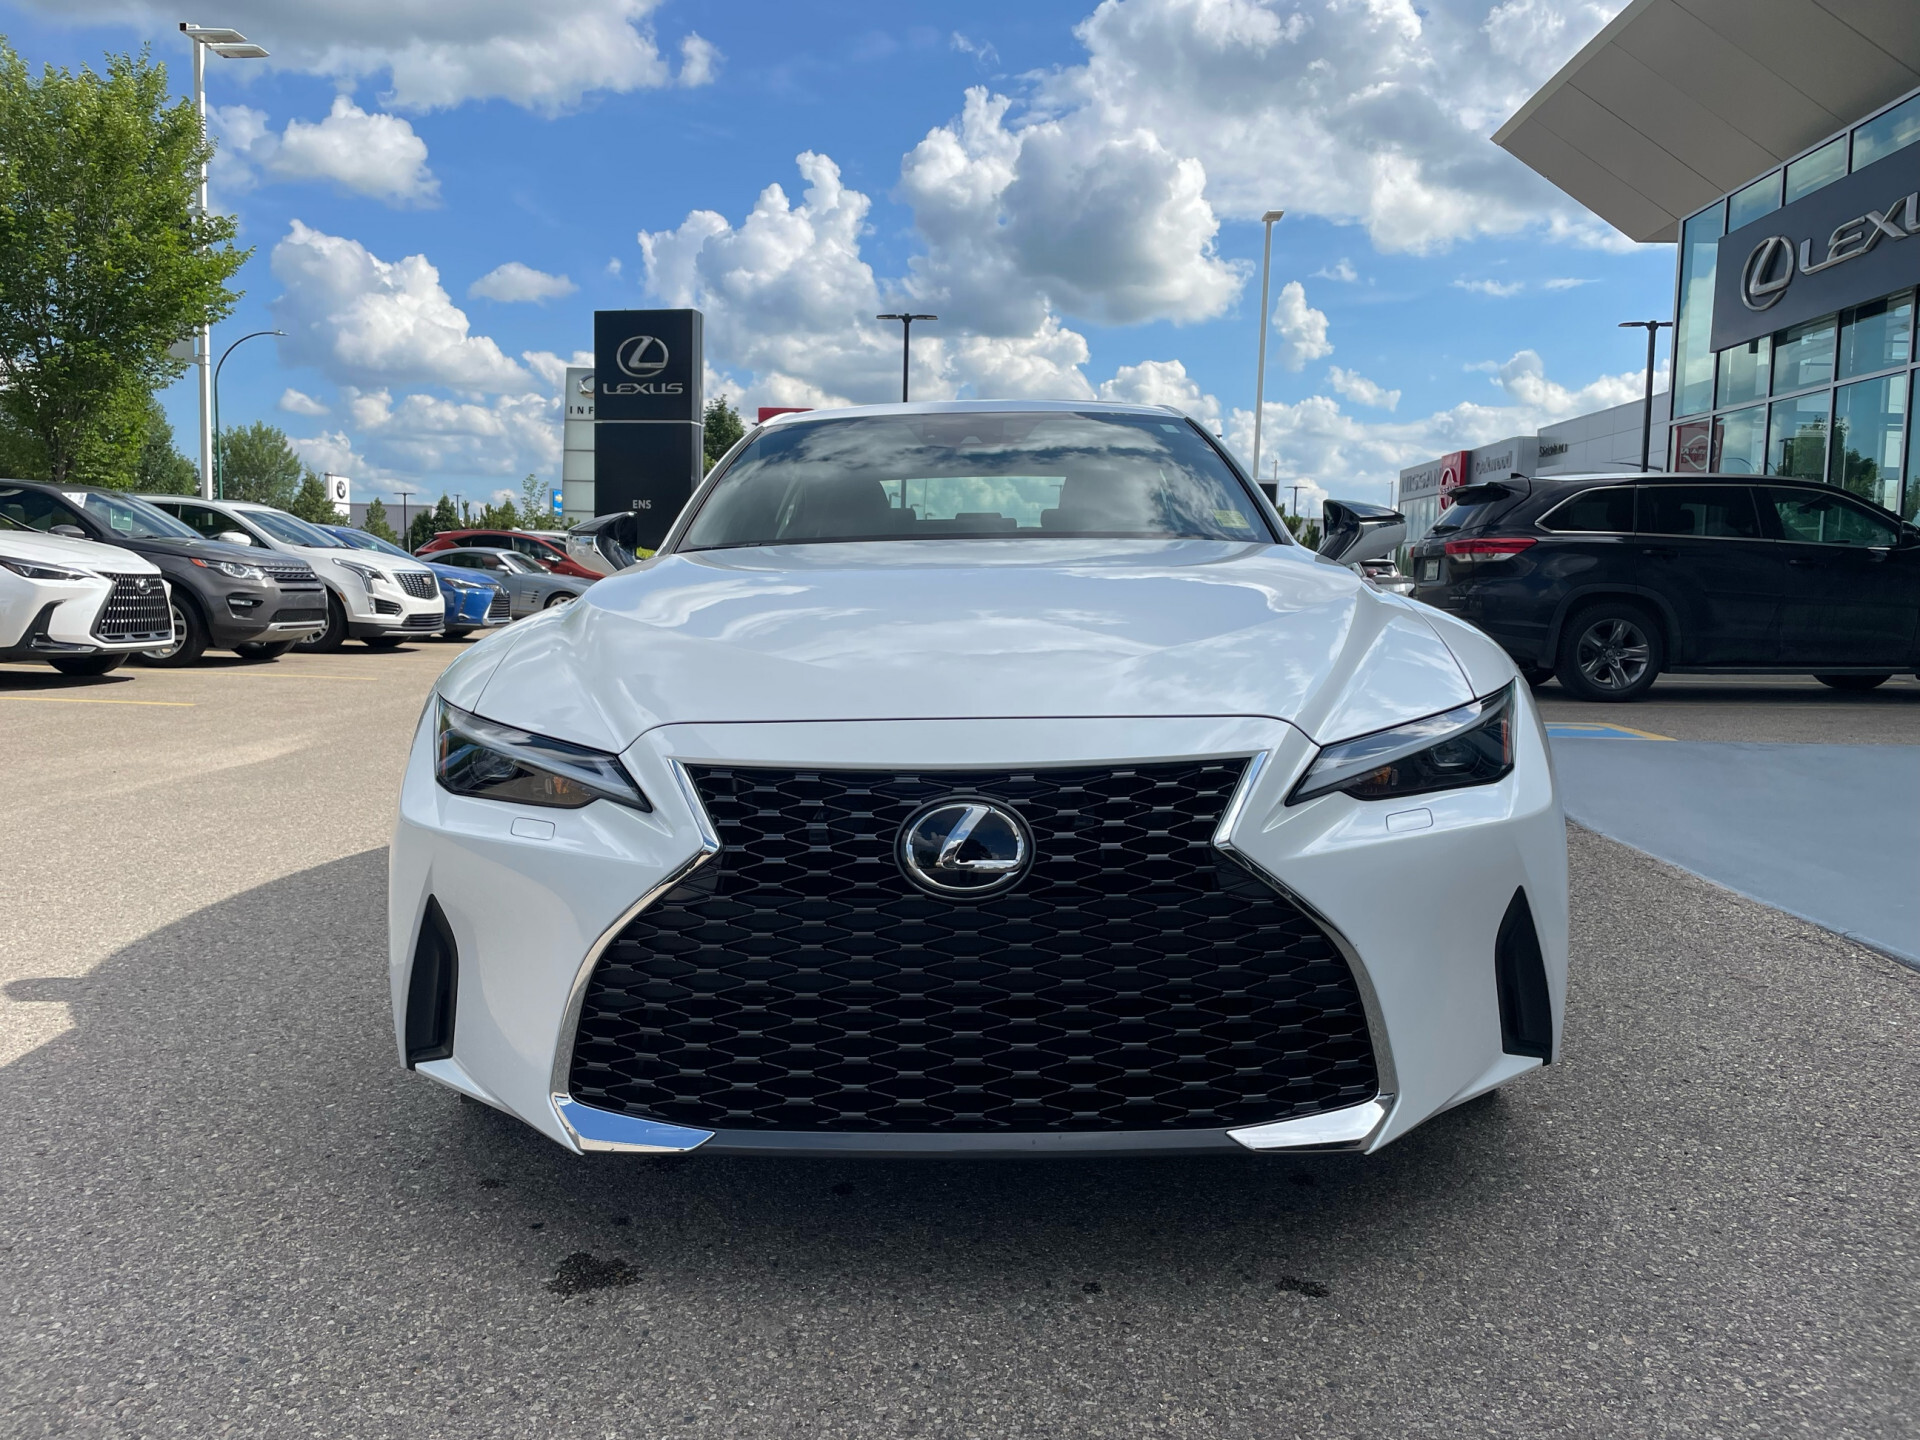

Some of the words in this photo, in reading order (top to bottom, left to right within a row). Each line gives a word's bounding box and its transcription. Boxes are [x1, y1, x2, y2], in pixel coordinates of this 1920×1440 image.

[602, 383, 684, 395] LEXUS
[1401, 467, 1442, 494] NISSAN
[632, 499, 652, 510] ENS
